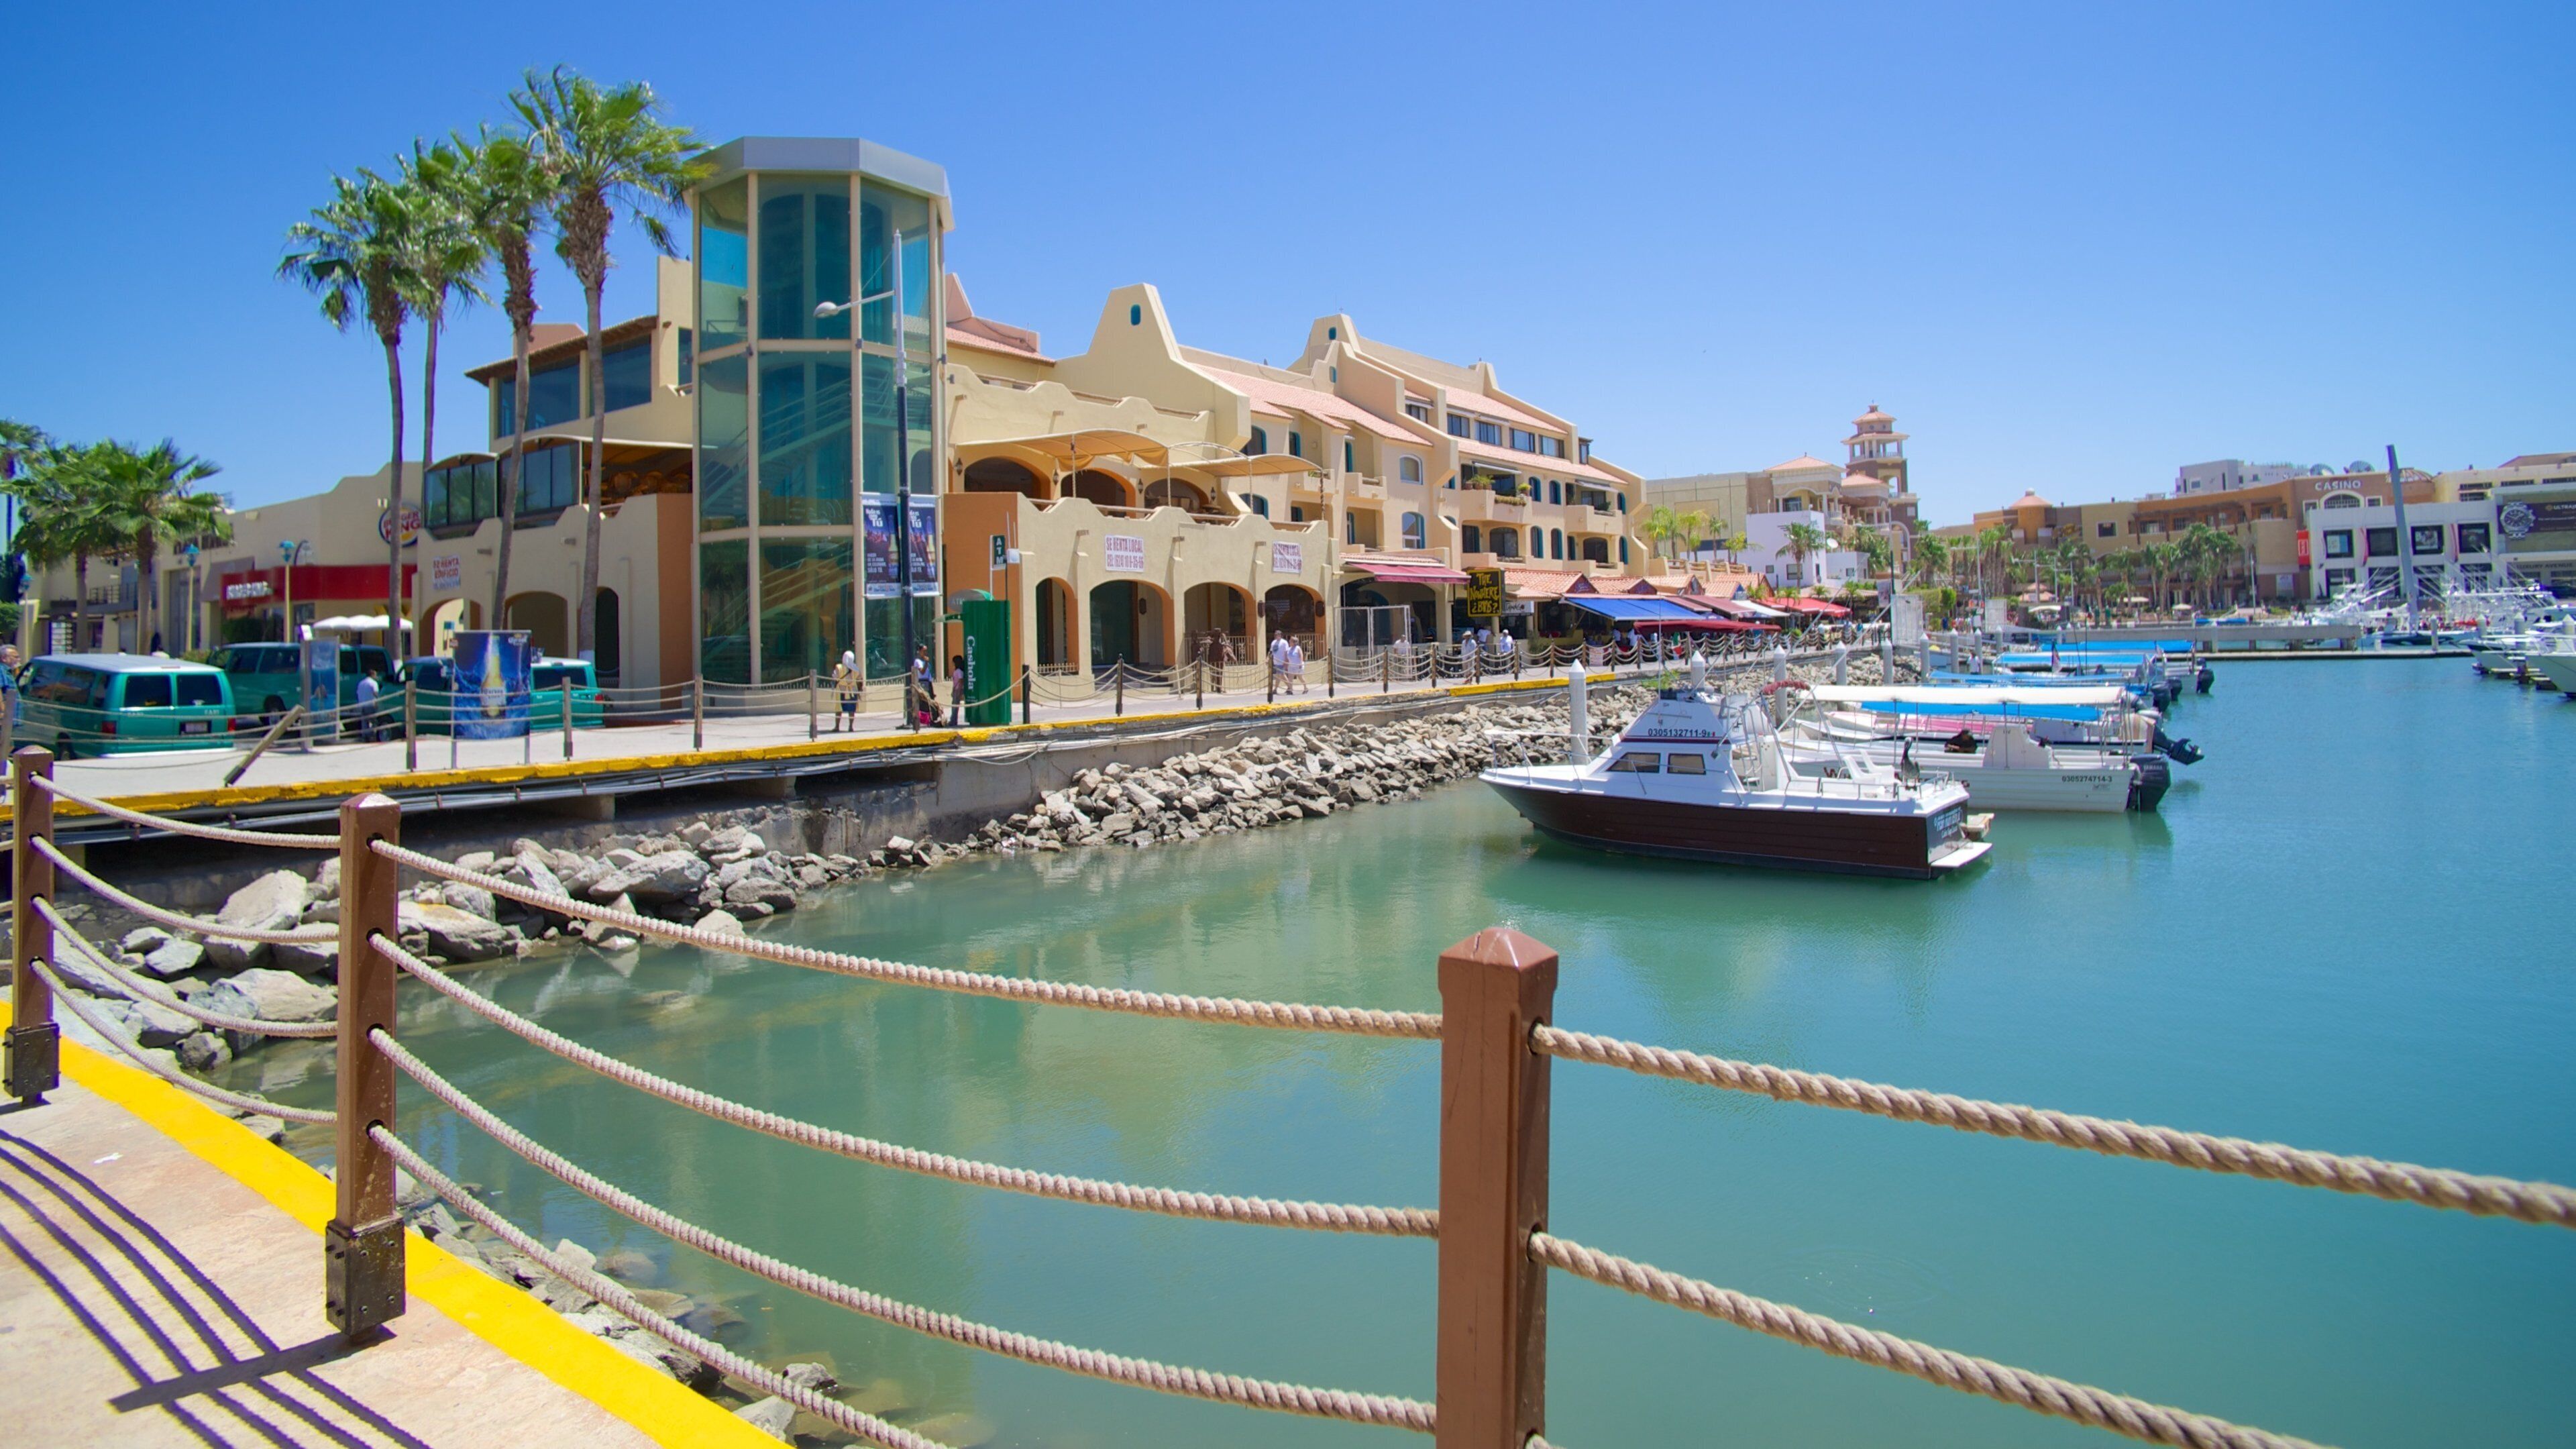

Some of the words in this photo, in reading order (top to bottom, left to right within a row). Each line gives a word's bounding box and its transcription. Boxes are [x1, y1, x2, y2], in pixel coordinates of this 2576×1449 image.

[2314, 479, 2362, 492] CASINO
[872, 518, 883, 527] Tú
[1107, 537, 1112, 550] SE
[1114, 537, 1128, 551] RENTA
[1128, 539, 1143, 553] LOCAL
[1477, 574, 1492, 586] THE
[1470, 586, 1499, 600] NOWHERE
[967, 635, 976, 690] Cashola
[1648, 728, 1707, 737] 0305132711-9
